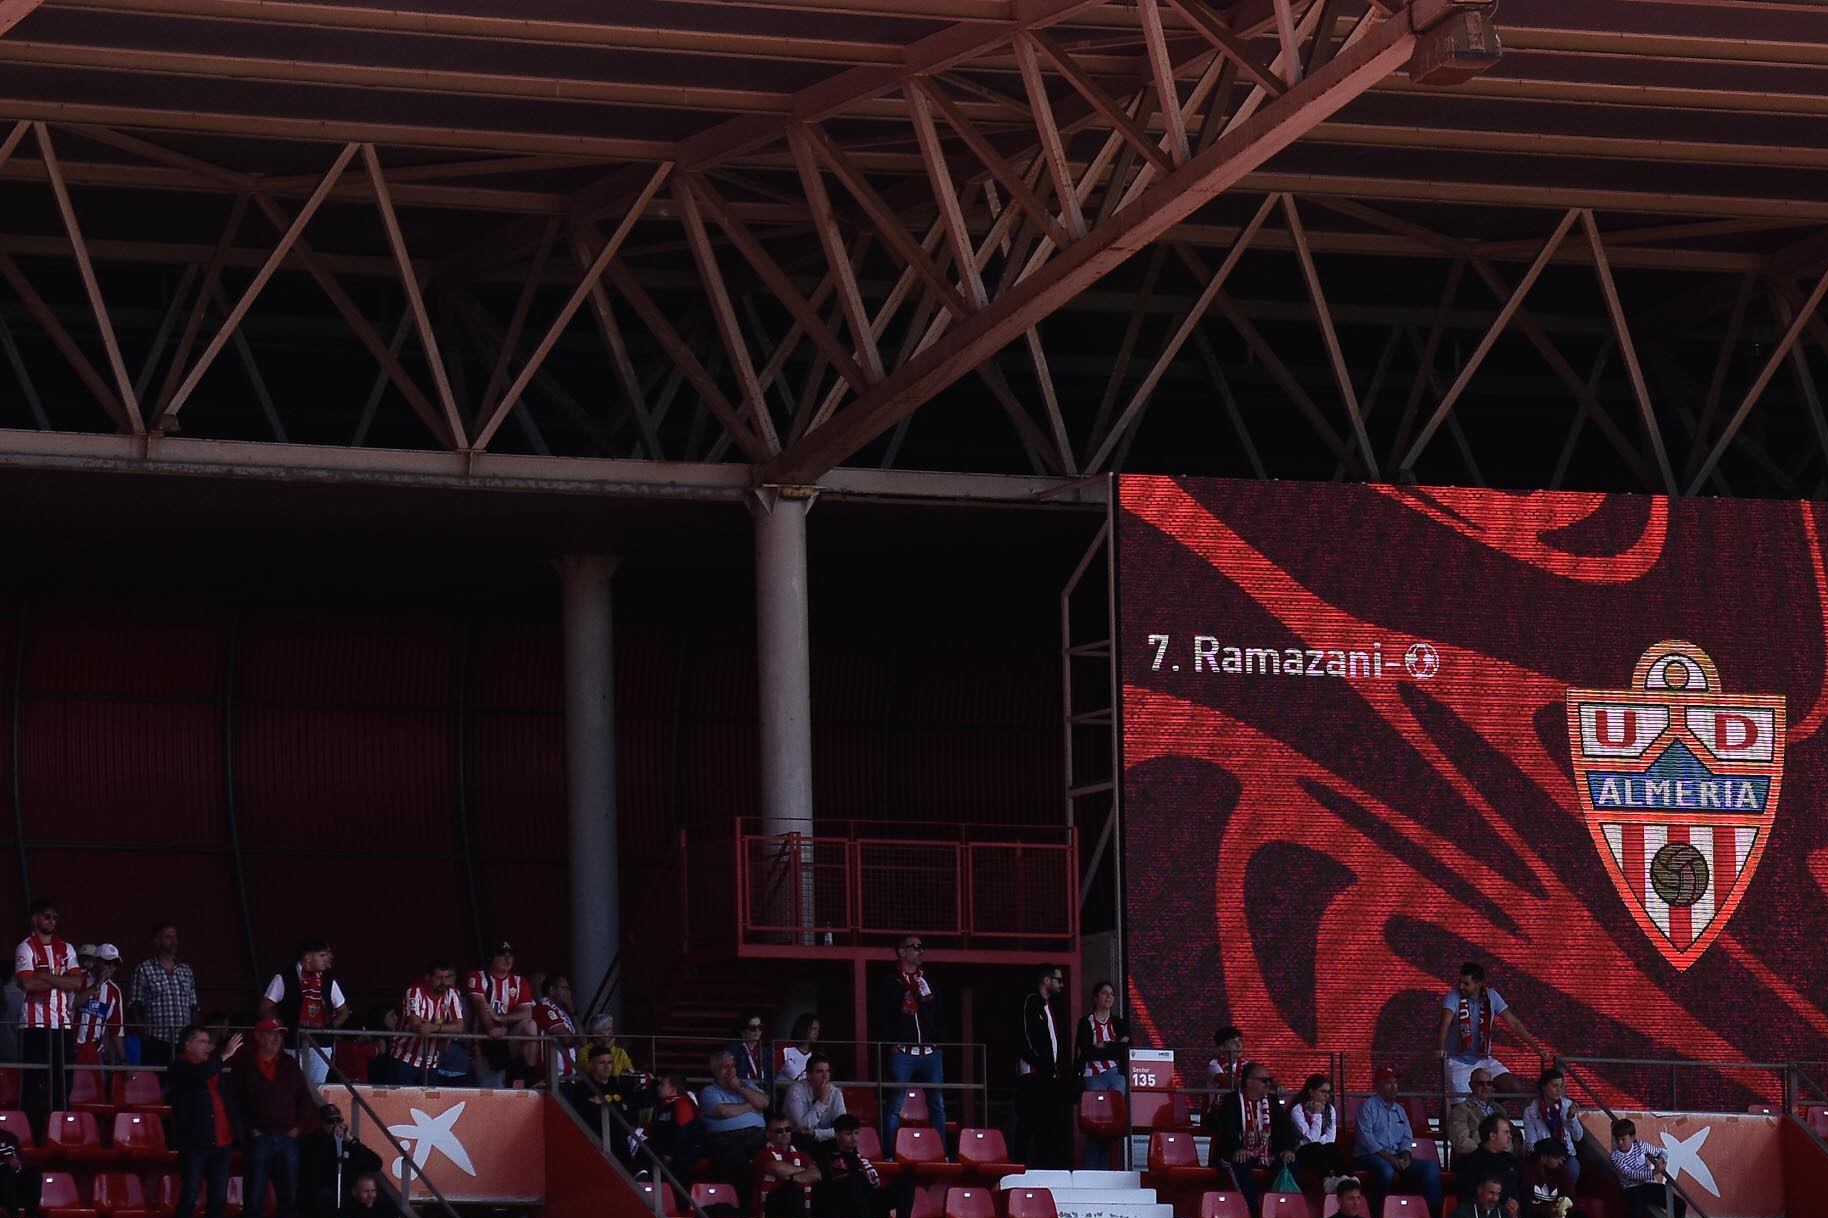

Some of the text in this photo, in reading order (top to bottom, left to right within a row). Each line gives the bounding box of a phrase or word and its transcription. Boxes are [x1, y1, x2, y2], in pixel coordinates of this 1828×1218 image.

[1148, 634, 1179, 671] 7.
[1594, 711, 1758, 751] U D
[1132, 1073, 1156, 1087] 135
